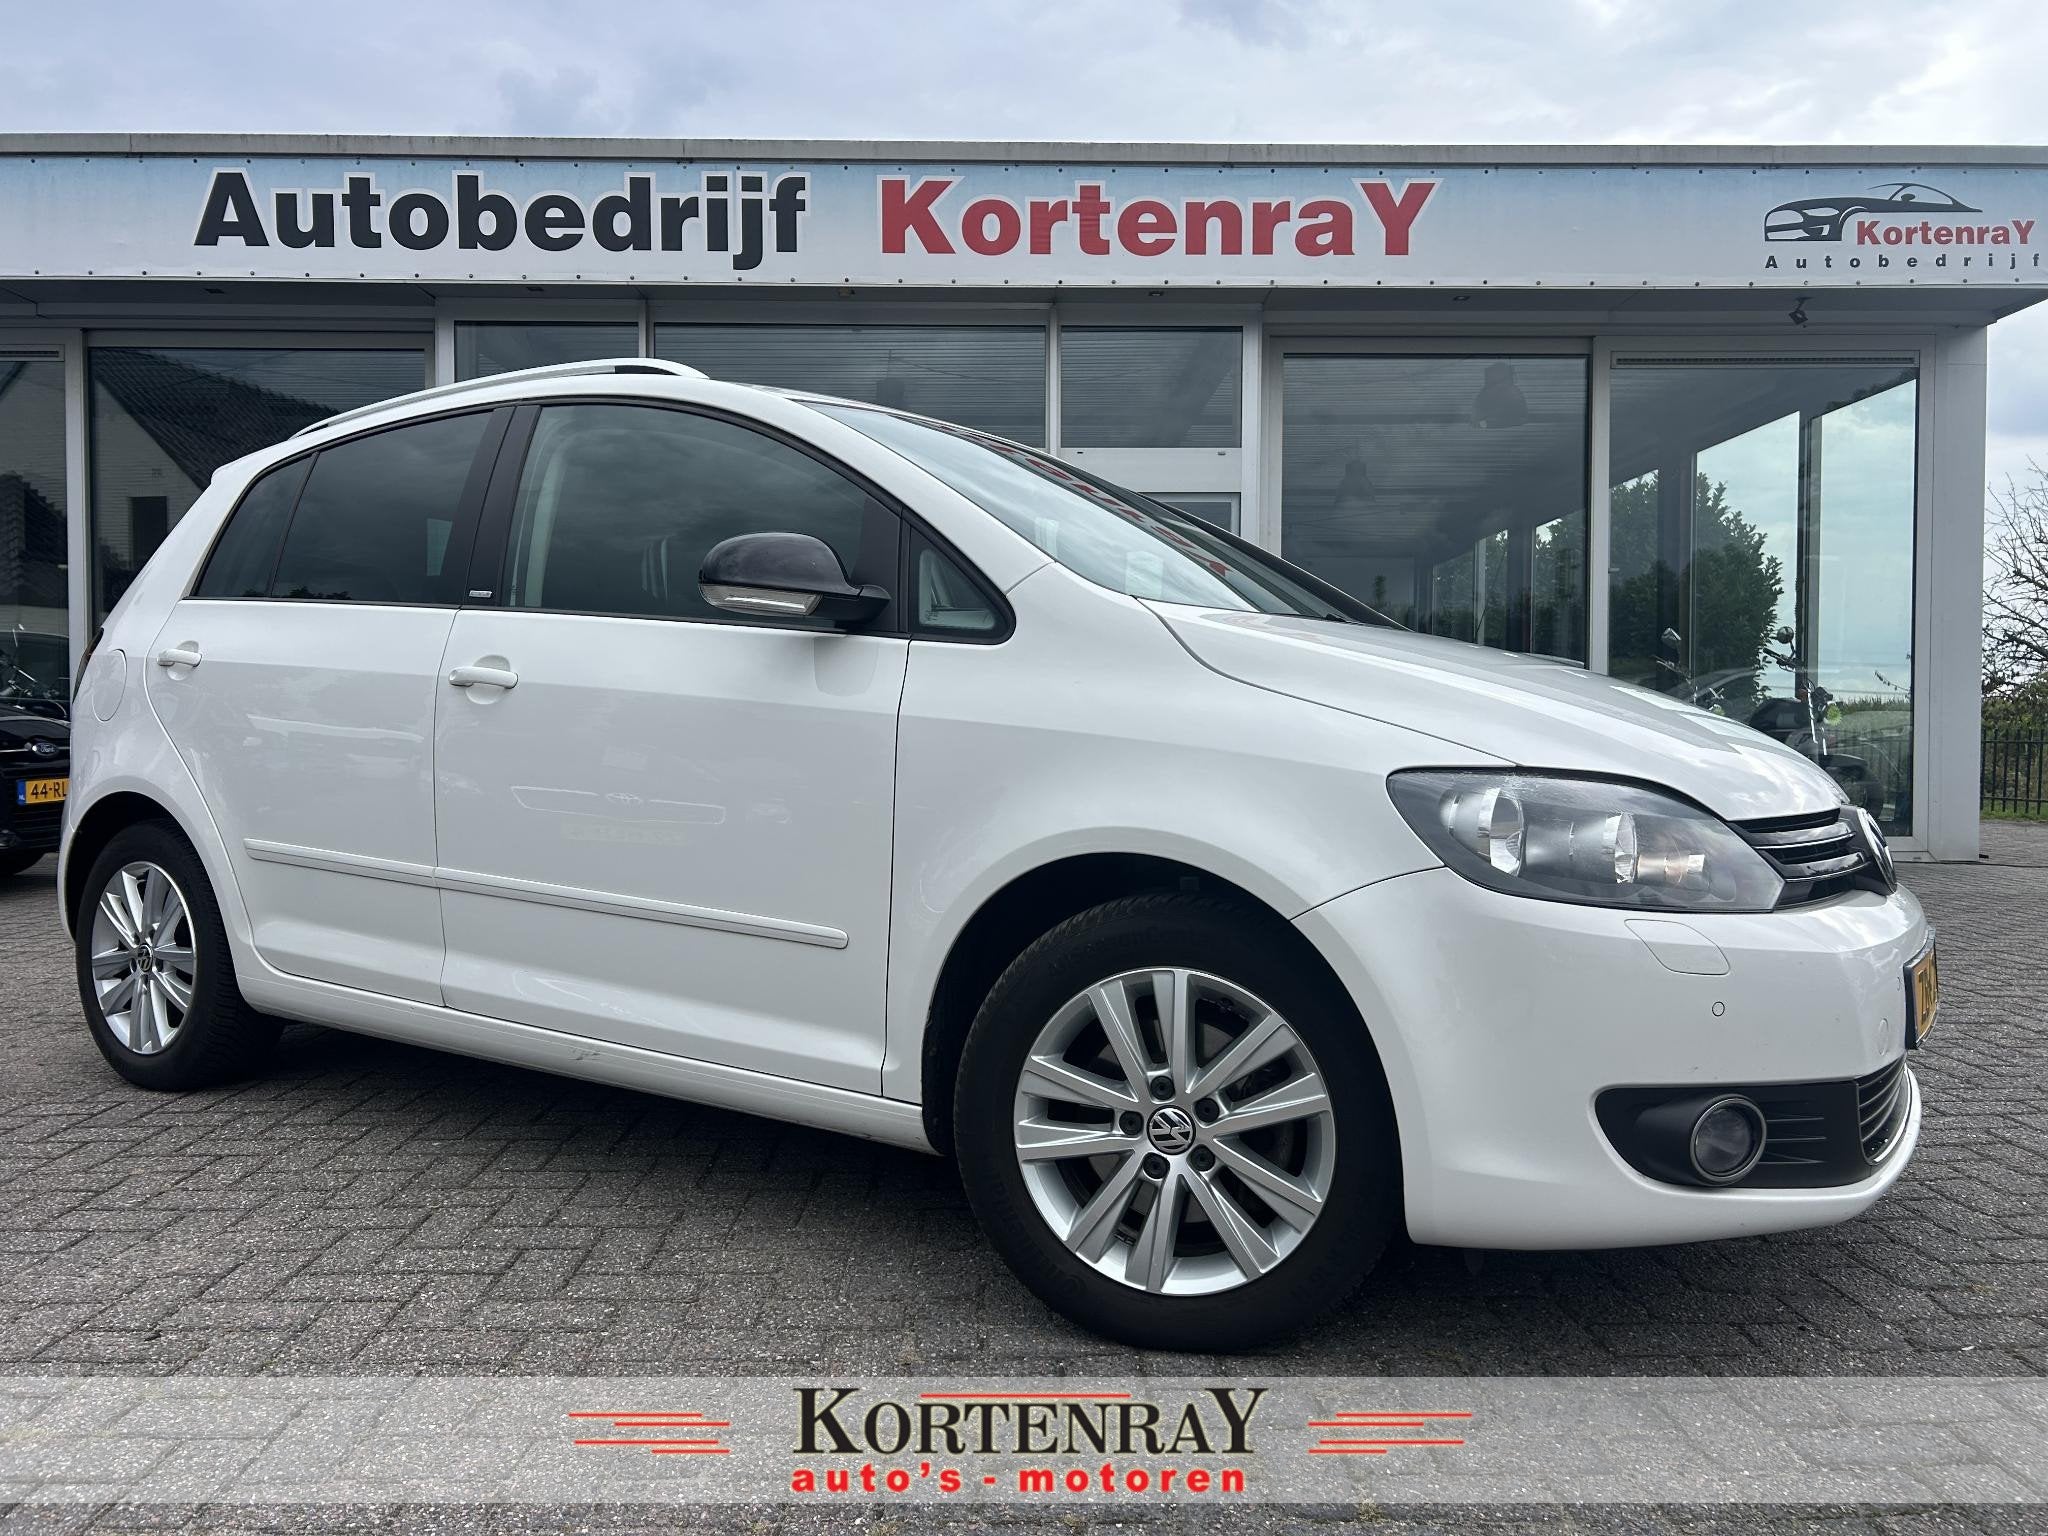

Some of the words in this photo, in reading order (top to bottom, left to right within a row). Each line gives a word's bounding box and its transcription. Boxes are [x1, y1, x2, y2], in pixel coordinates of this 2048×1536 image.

[195, 172, 807, 270] Autobedrijf
[881, 178, 1434, 257] KortenraY
[1857, 220, 2035, 246] KortenraY
